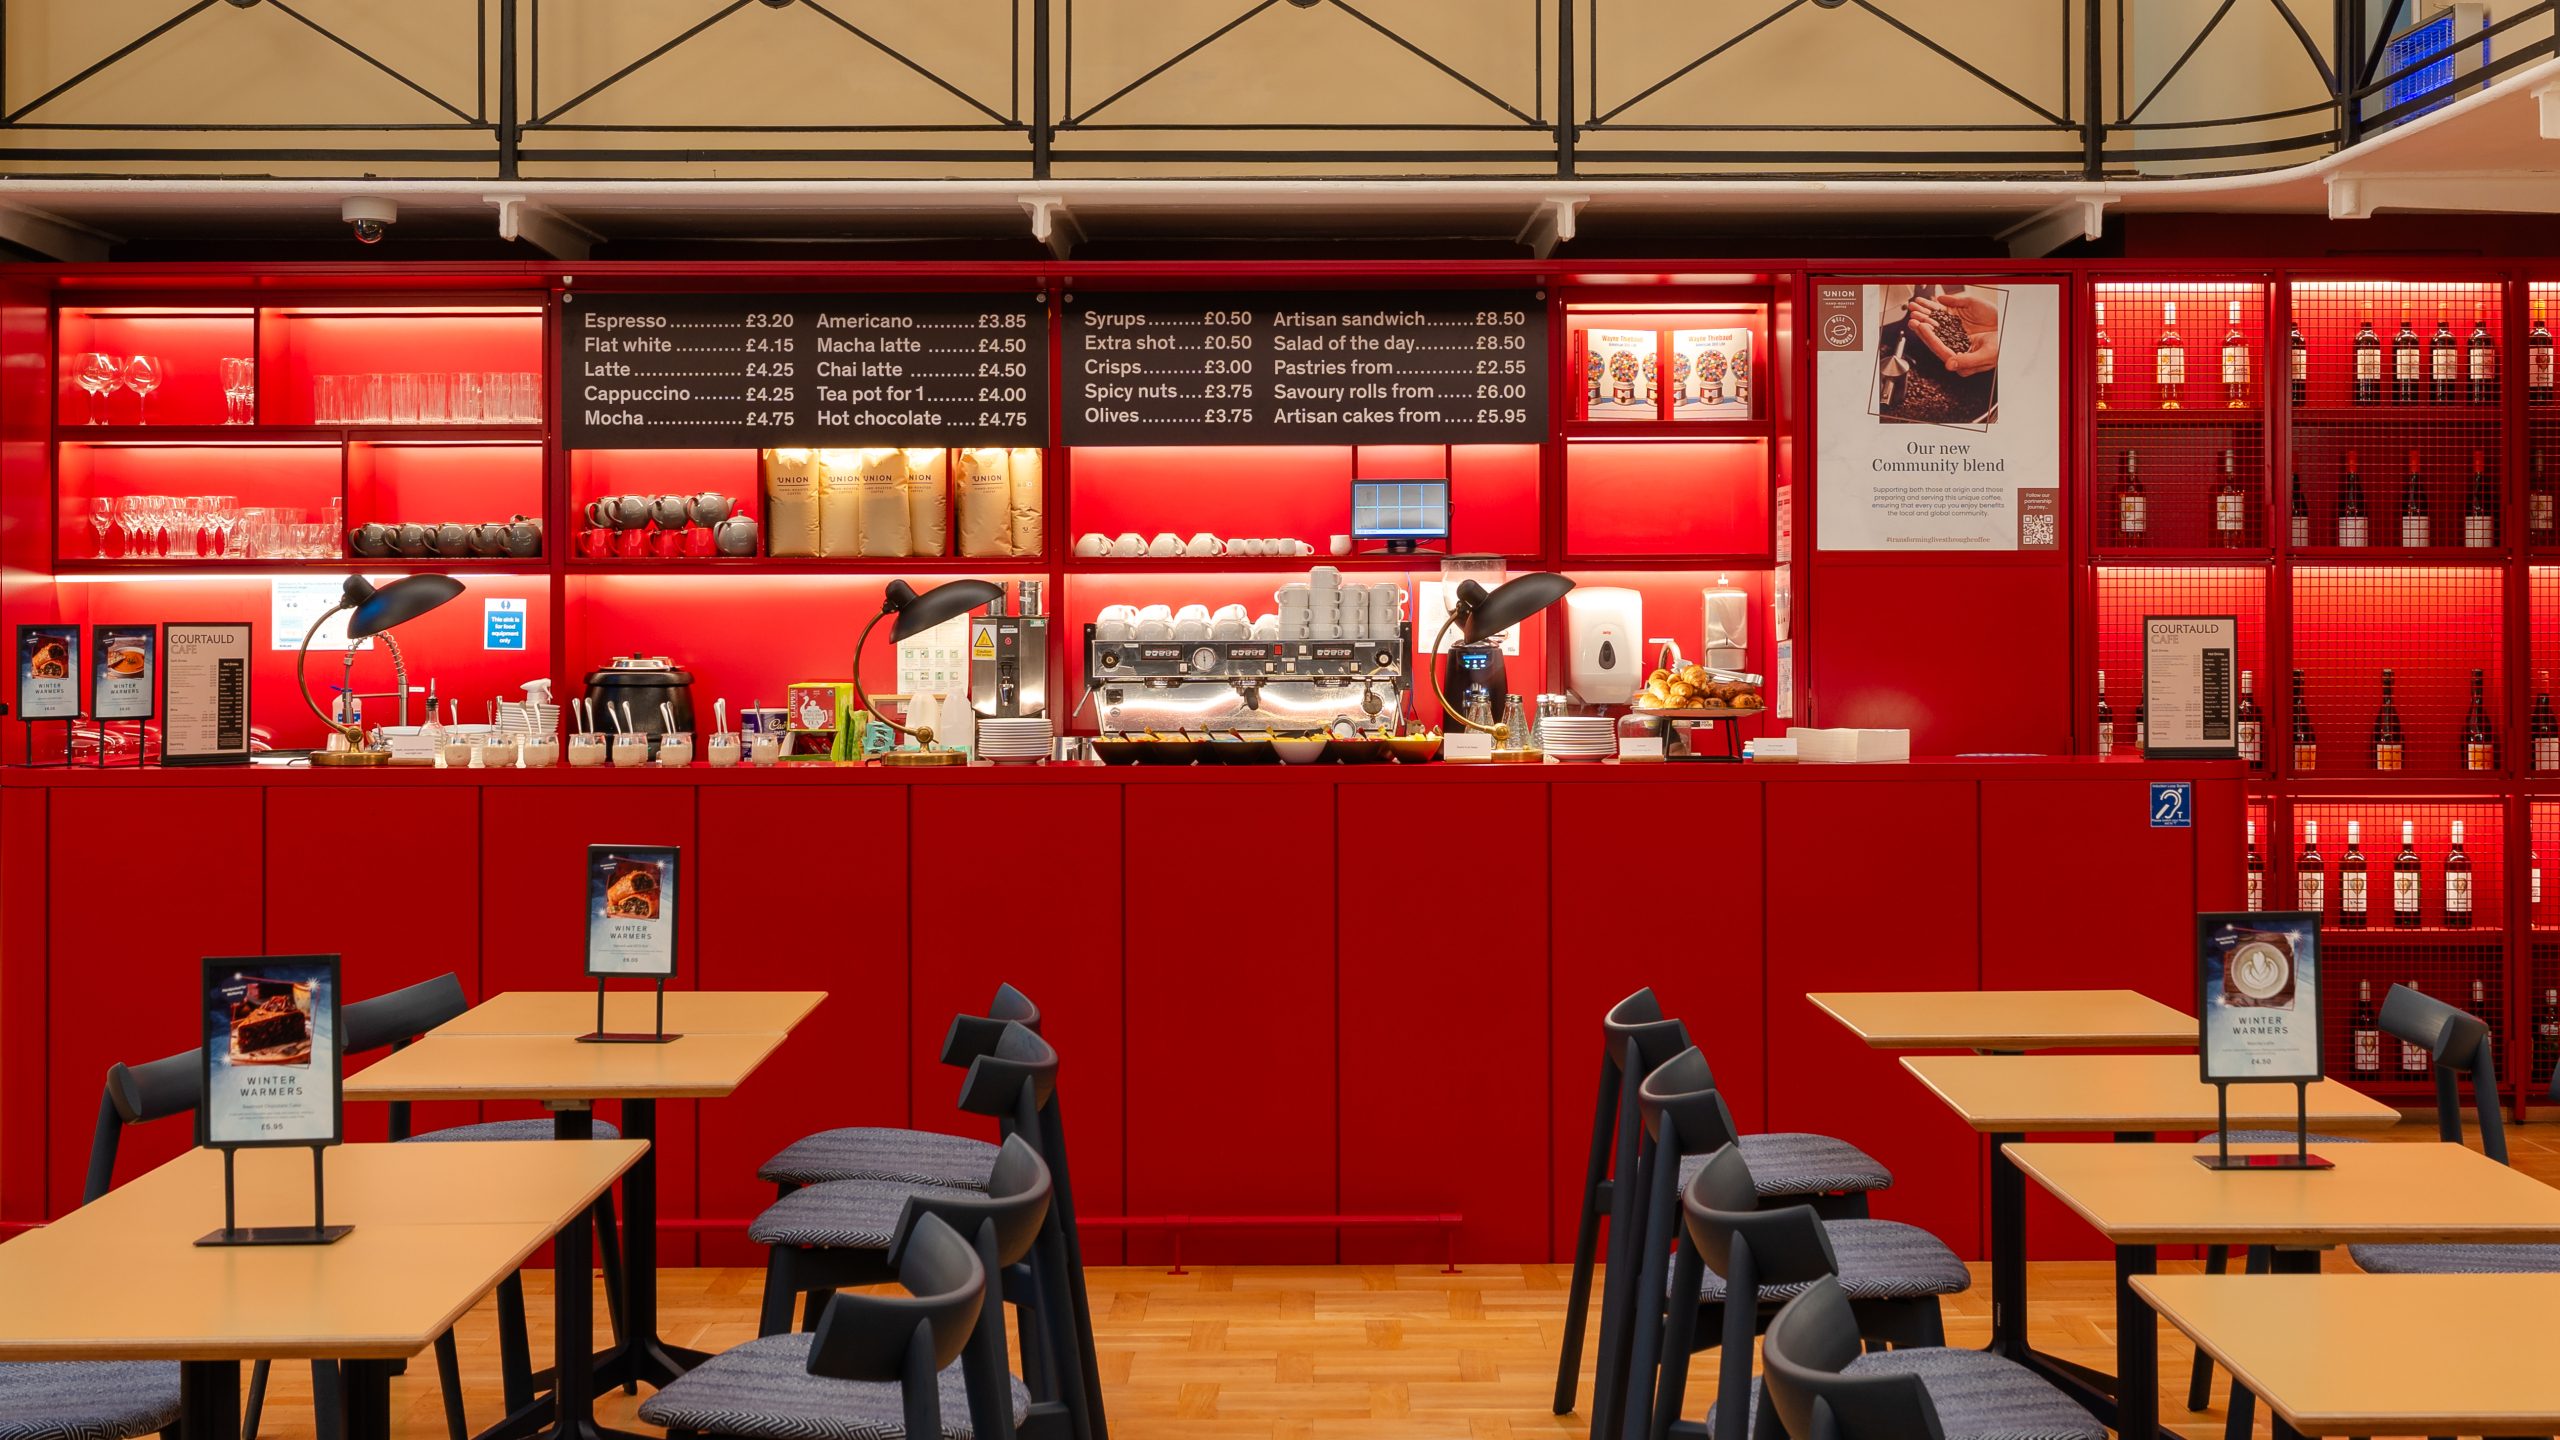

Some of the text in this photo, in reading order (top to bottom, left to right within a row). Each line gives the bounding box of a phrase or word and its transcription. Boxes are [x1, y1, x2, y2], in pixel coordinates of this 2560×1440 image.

[585, 313, 794, 331] Espresso £3.20
[817, 313, 1027, 329] Americano £3.85
[1085, 311, 1252, 330] Syrups £0.50
[1274, 310, 1525, 327] Artisan sandwich £8.50
[585, 336, 793, 353] Flat white £4.15
[817, 337, 1027, 353] Macha latte £4.50
[1085, 334, 1252, 350] Extra shot £0.50
[1274, 335, 1526, 354] Salad of the day £8.50
[585, 361, 794, 377] Latte £4.25
[817, 361, 1027, 377] Chai latte £4.50
[1085, 358, 1252, 377] Crisps £3.00
[1274, 359, 1526, 375] Pastries from £2.55
[585, 386, 794, 405] Cappuccino £4.25
[817, 386, 1027, 405] Tea pot for 1 £4.00
[1085, 383, 1253, 402] Spicy nuts £3.75
[1274, 383, 1526, 402] Savoury rolls from £6.00
[585, 410, 795, 426] Mocha £4.75
[817, 410, 1027, 427] Hot chocolate £4.75
[1085, 408, 1253, 423] Olives £3.75
[1274, 407, 1527, 424] Artisan cakes from £5.95
[1906, 442, 1970, 454] Our new
[1872, 458, 2004, 474] Community blend
[2151, 625, 2219, 634] COURTAULD
[171, 634, 234, 644] COURTAULD
[248, 1076, 296, 1085] WINTER
[240, 1087, 303, 1096] WARMERS
